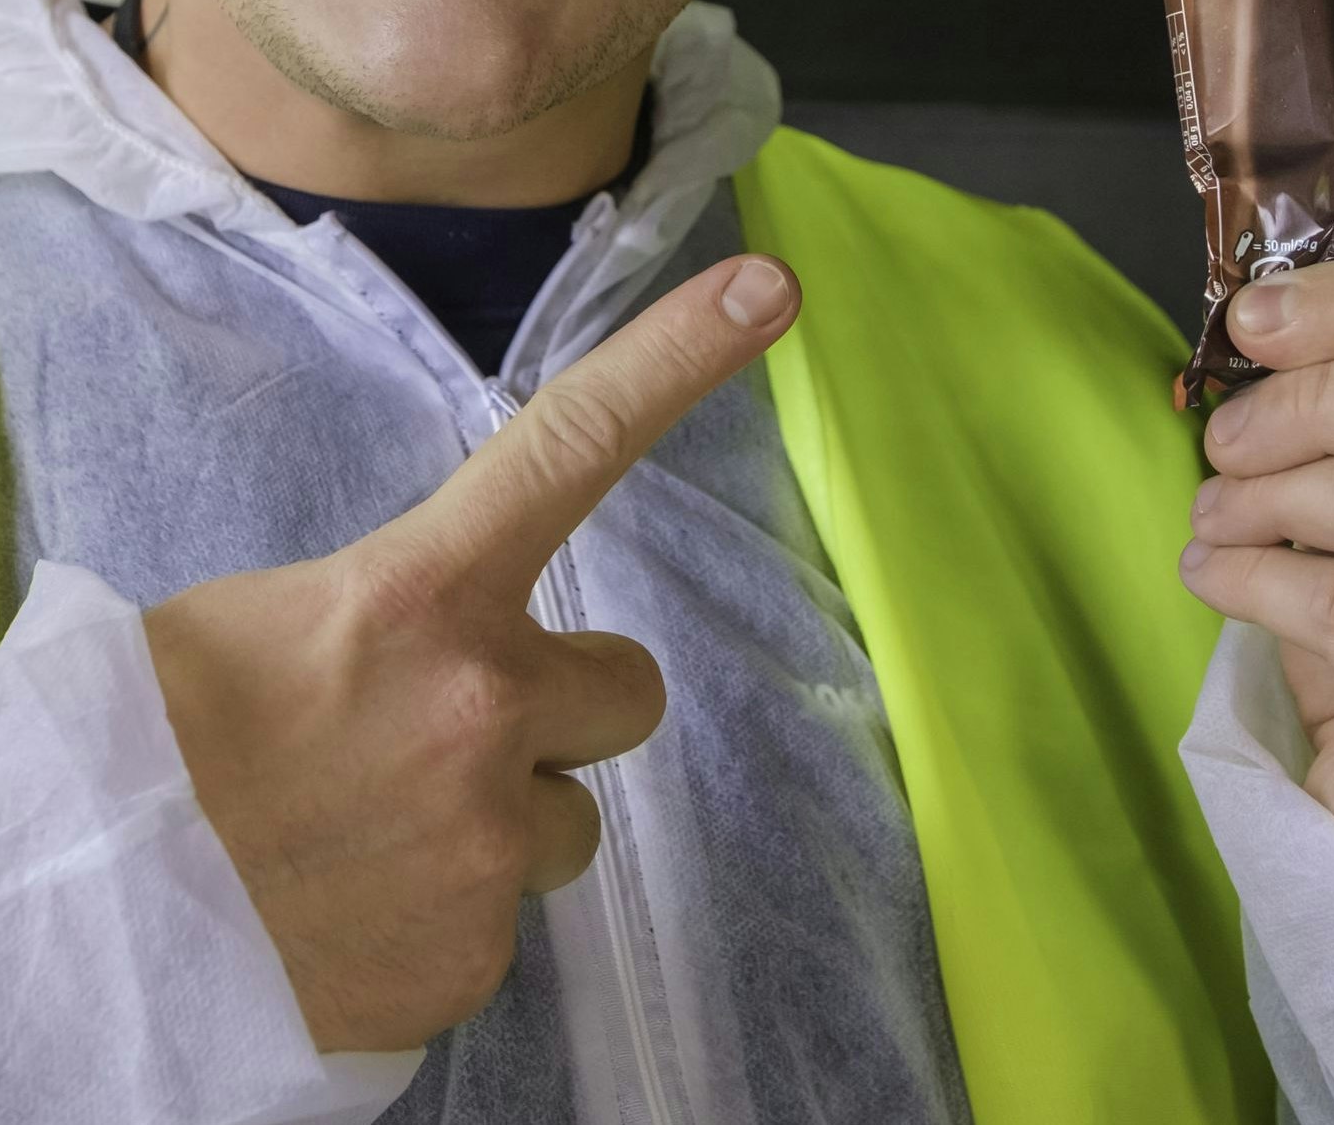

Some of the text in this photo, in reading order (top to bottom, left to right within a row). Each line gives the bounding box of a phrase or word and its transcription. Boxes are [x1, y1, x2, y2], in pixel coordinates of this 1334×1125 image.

[1185, 90, 1194, 110] 0,04
[1264, 239, 1279, 252] 50
[1309, 241, 1318, 253] g
